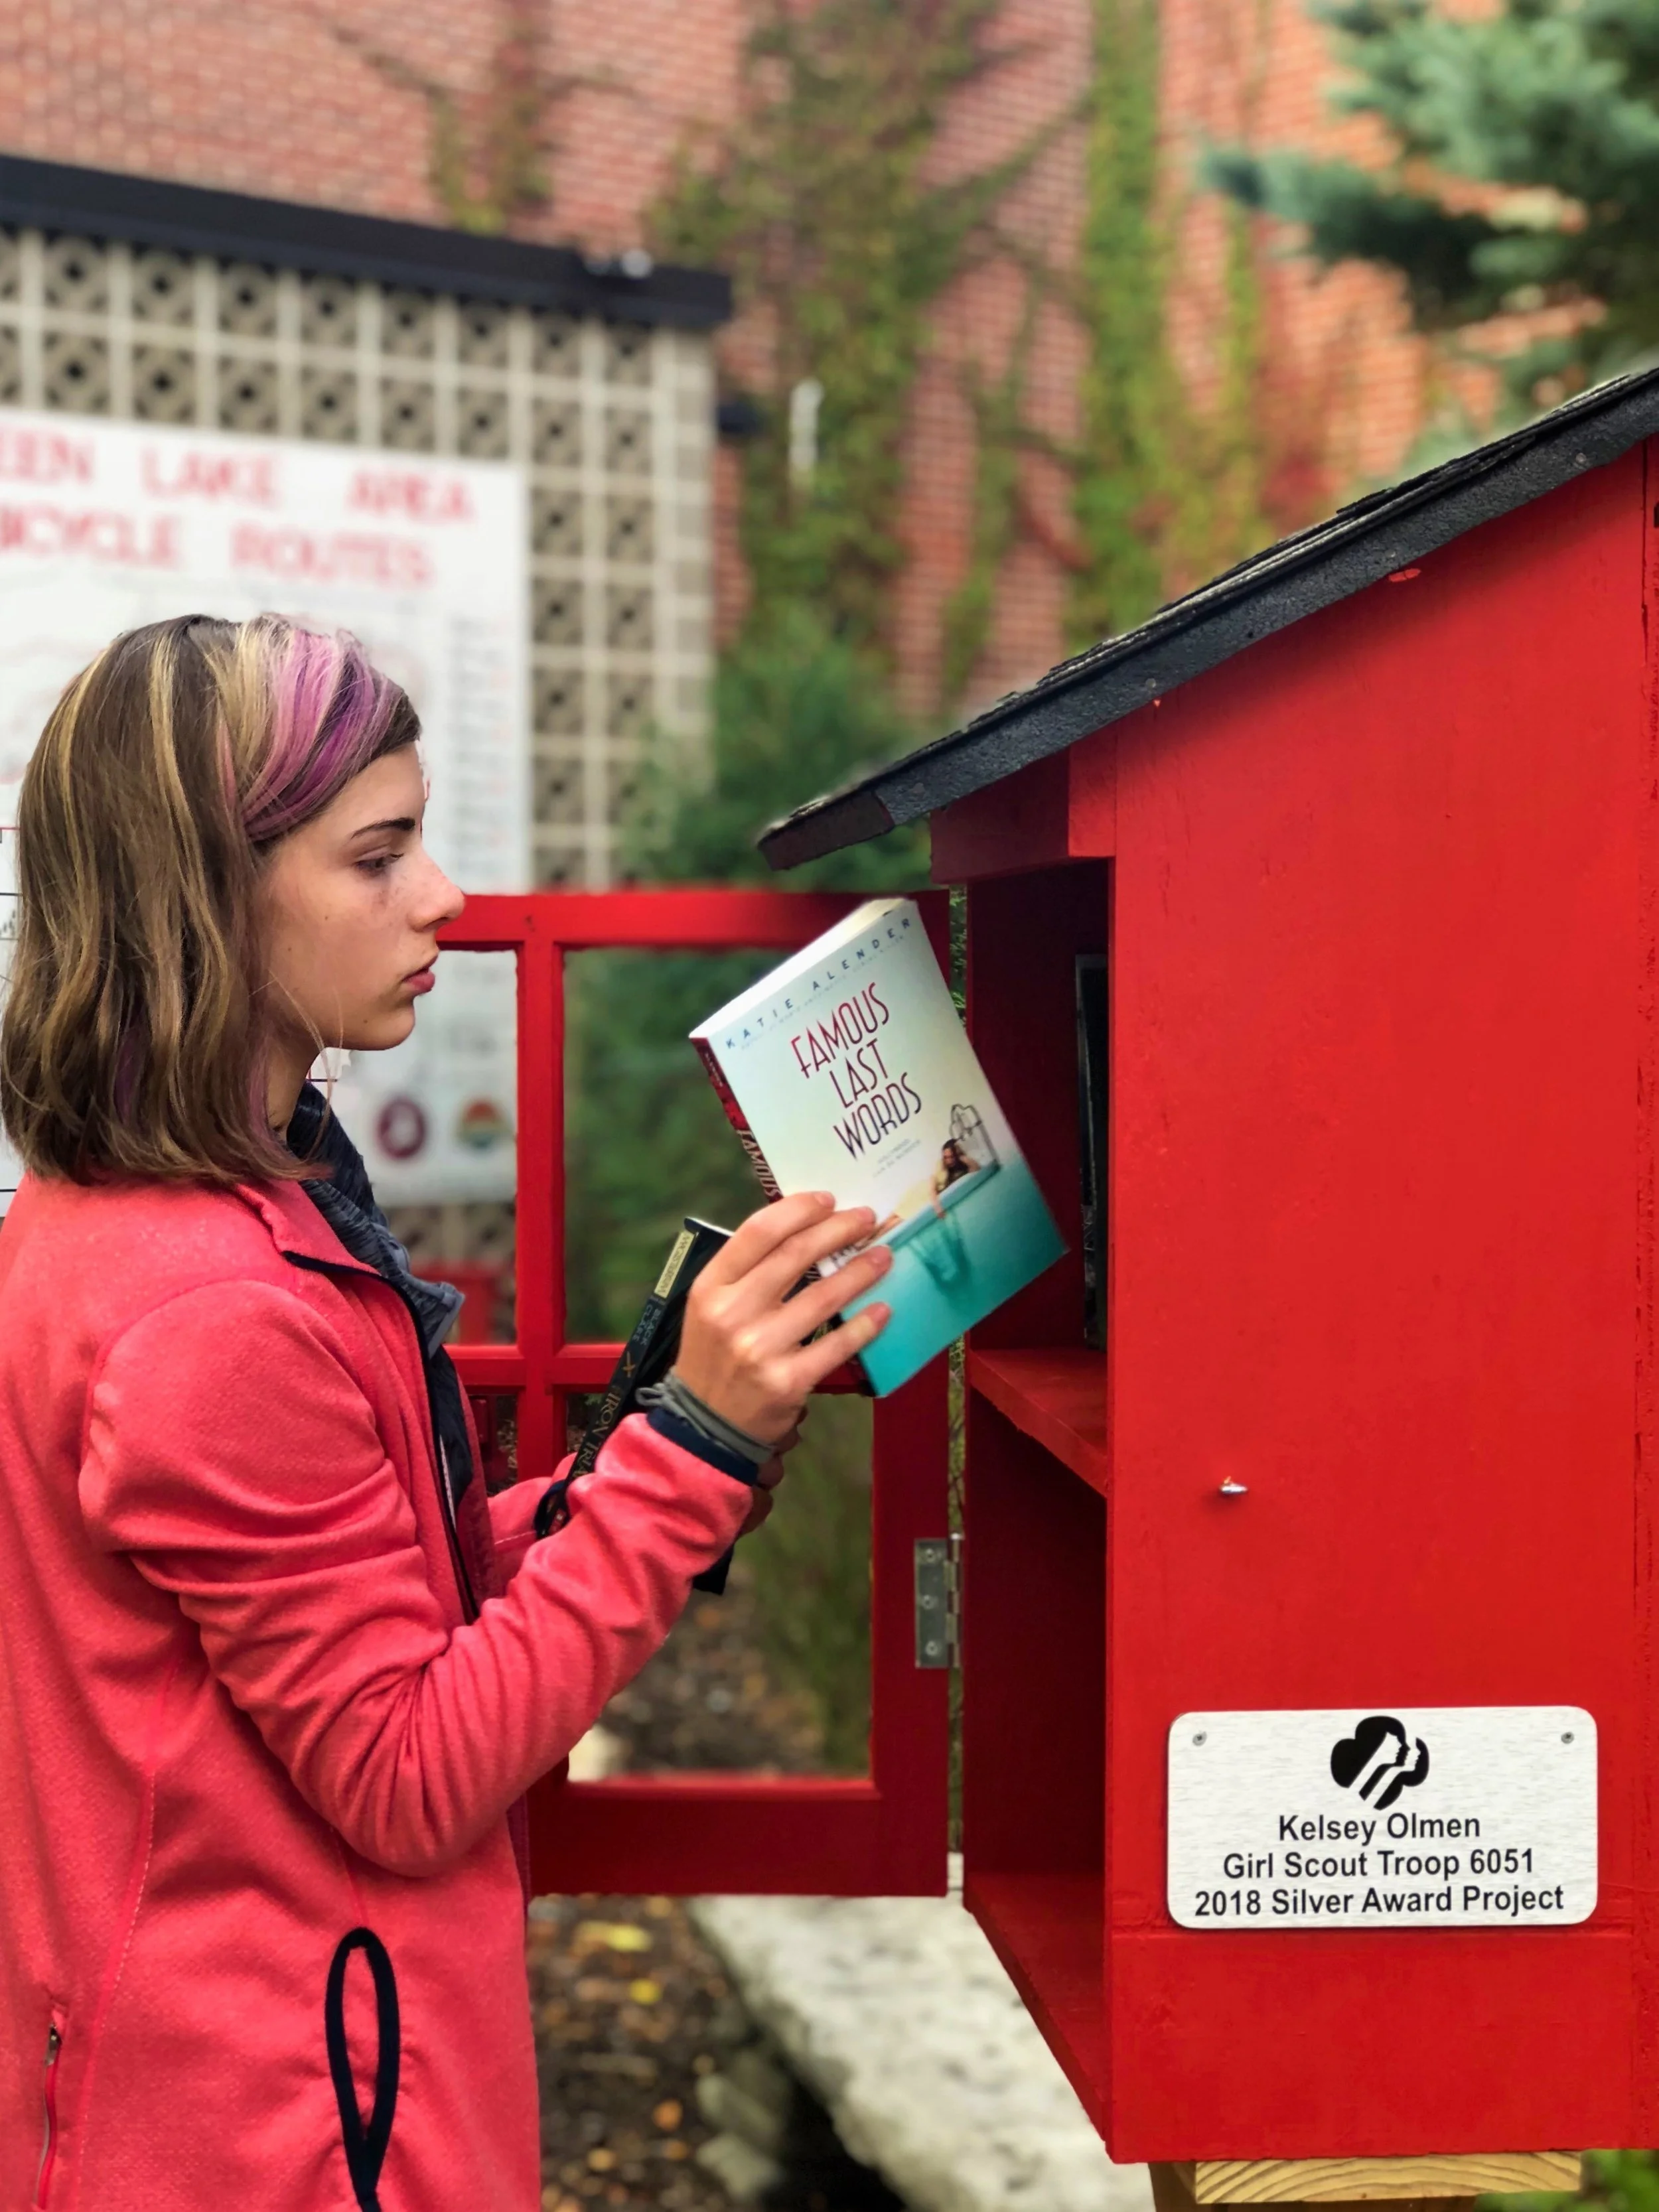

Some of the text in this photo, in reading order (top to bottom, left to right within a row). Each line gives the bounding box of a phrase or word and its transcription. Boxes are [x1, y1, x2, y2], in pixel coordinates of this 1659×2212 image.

[141, 446, 279, 510] LAKE
[350, 468, 475, 524] AREA
[231, 521, 438, 590] ROUTES
[725, 918, 910, 1049] KATIE ALENDER
[790, 982, 889, 1079] FAMOUS
[829, 1038, 889, 1109] LAST
[833, 1071, 922, 1161] WORDS
[736, 1129, 782, 1197] FAMOUS
[639, 1308, 662, 1346] BLACK
[590, 1392, 622, 1438] IRON
[571, 1436, 601, 1480] TRIA
[1279, 1813, 1480, 1846] Kelsey Olmen
[1224, 1848, 1532, 1881] Girl Scout Troop 6051
[1195, 1885, 1564, 1917] 2018 Silver Award Project
